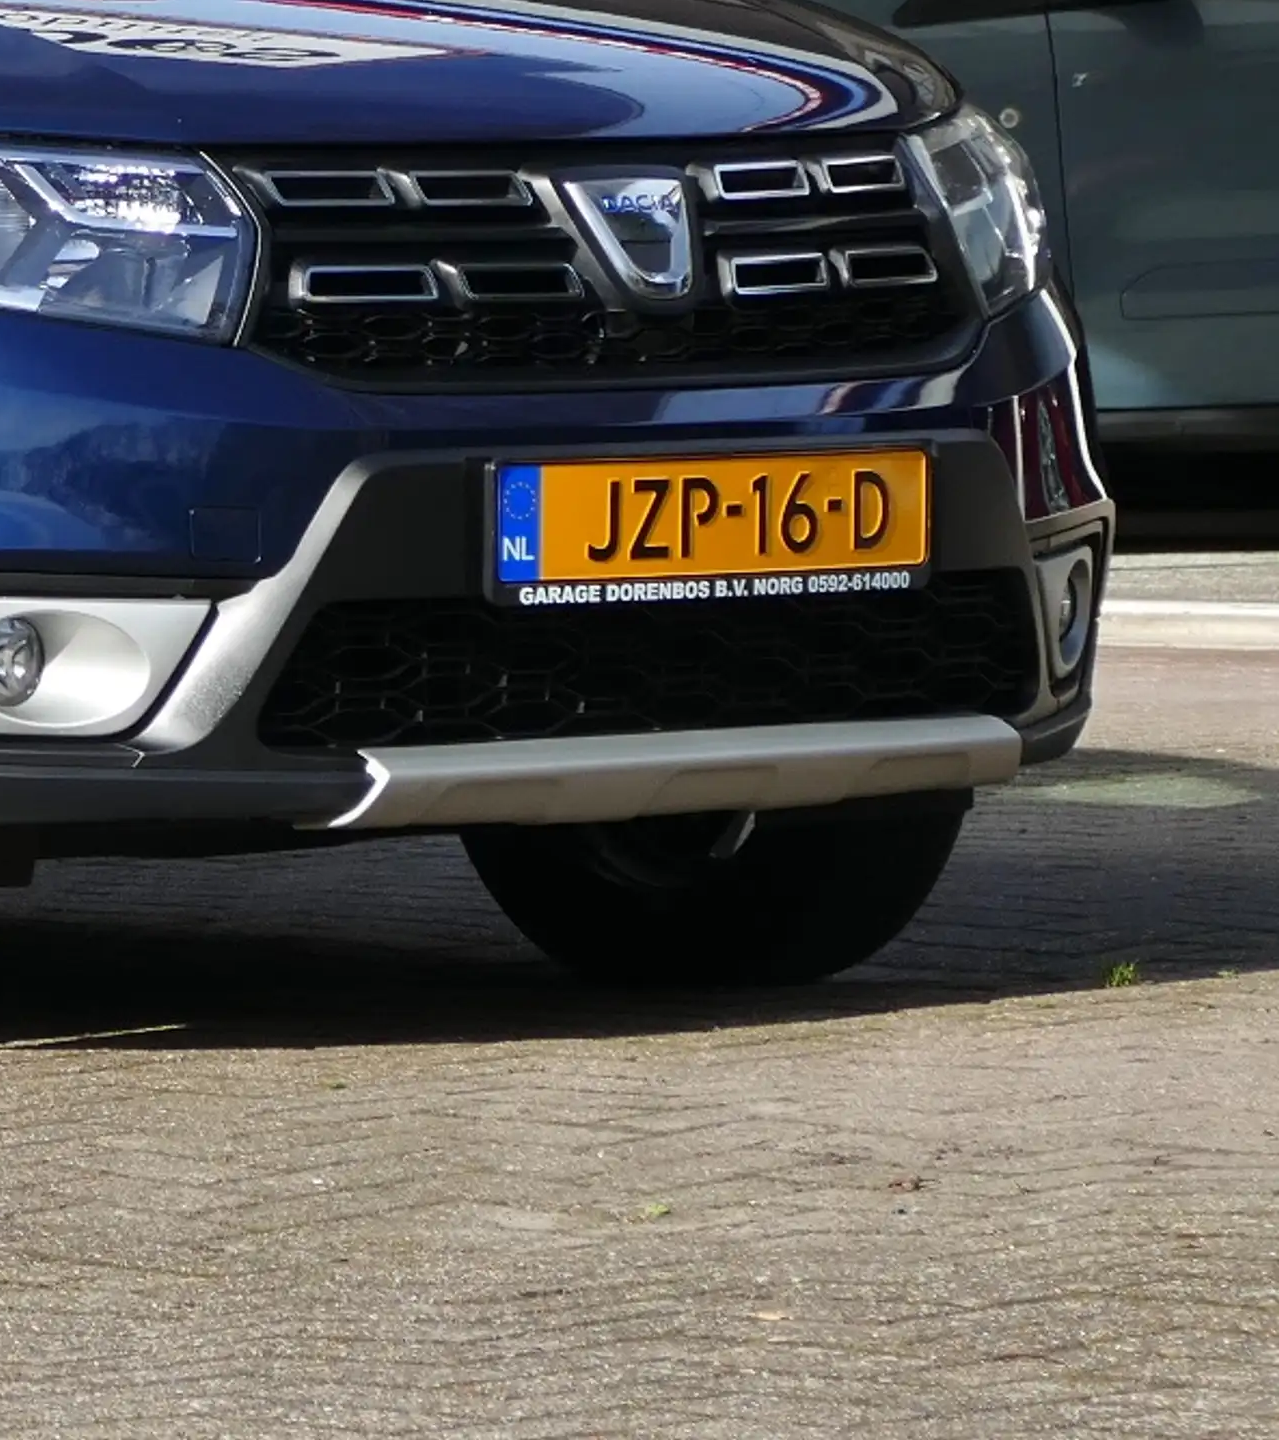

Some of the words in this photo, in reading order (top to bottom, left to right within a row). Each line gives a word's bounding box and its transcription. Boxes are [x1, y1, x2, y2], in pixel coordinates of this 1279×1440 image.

[601, 194, 679, 214] DACIA
[586, 469, 892, 562] JZP-16-D
[502, 536, 536, 562] NL
[519, 583, 600, 606] GARAGE
[605, 580, 710, 603] DORENBOS
[715, 578, 748, 598] B.V.
[754, 577, 804, 596] NORG
[808, 572, 910, 593] 0592-614000
